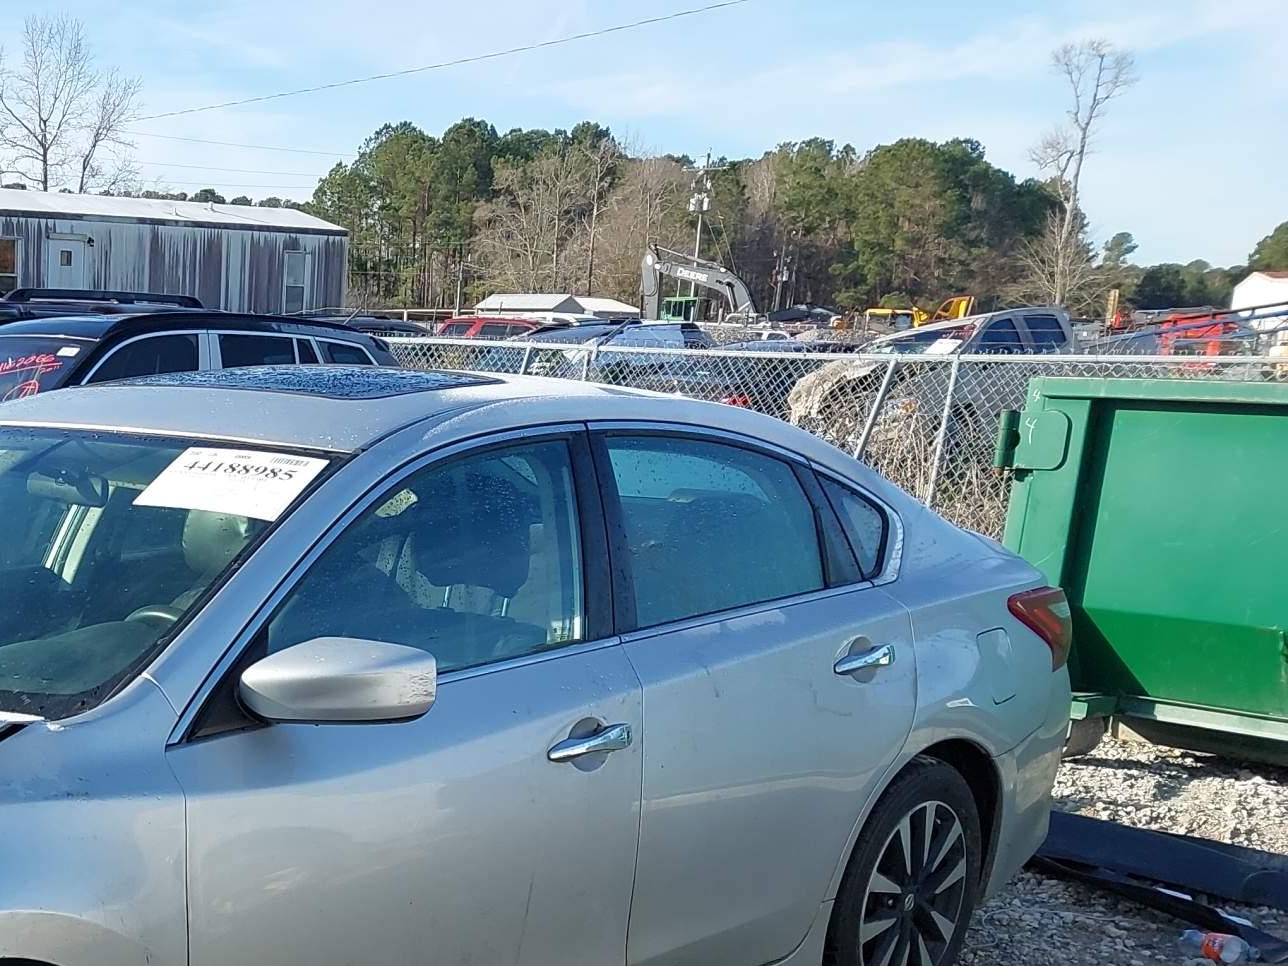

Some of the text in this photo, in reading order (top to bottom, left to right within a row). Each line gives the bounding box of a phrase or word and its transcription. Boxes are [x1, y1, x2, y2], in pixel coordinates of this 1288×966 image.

[677, 267, 709, 281] DEERE
[1032, 389, 1040, 401] 4
[1025, 417, 1038, 445] 4
[183, 460, 297, 481] 44188985
